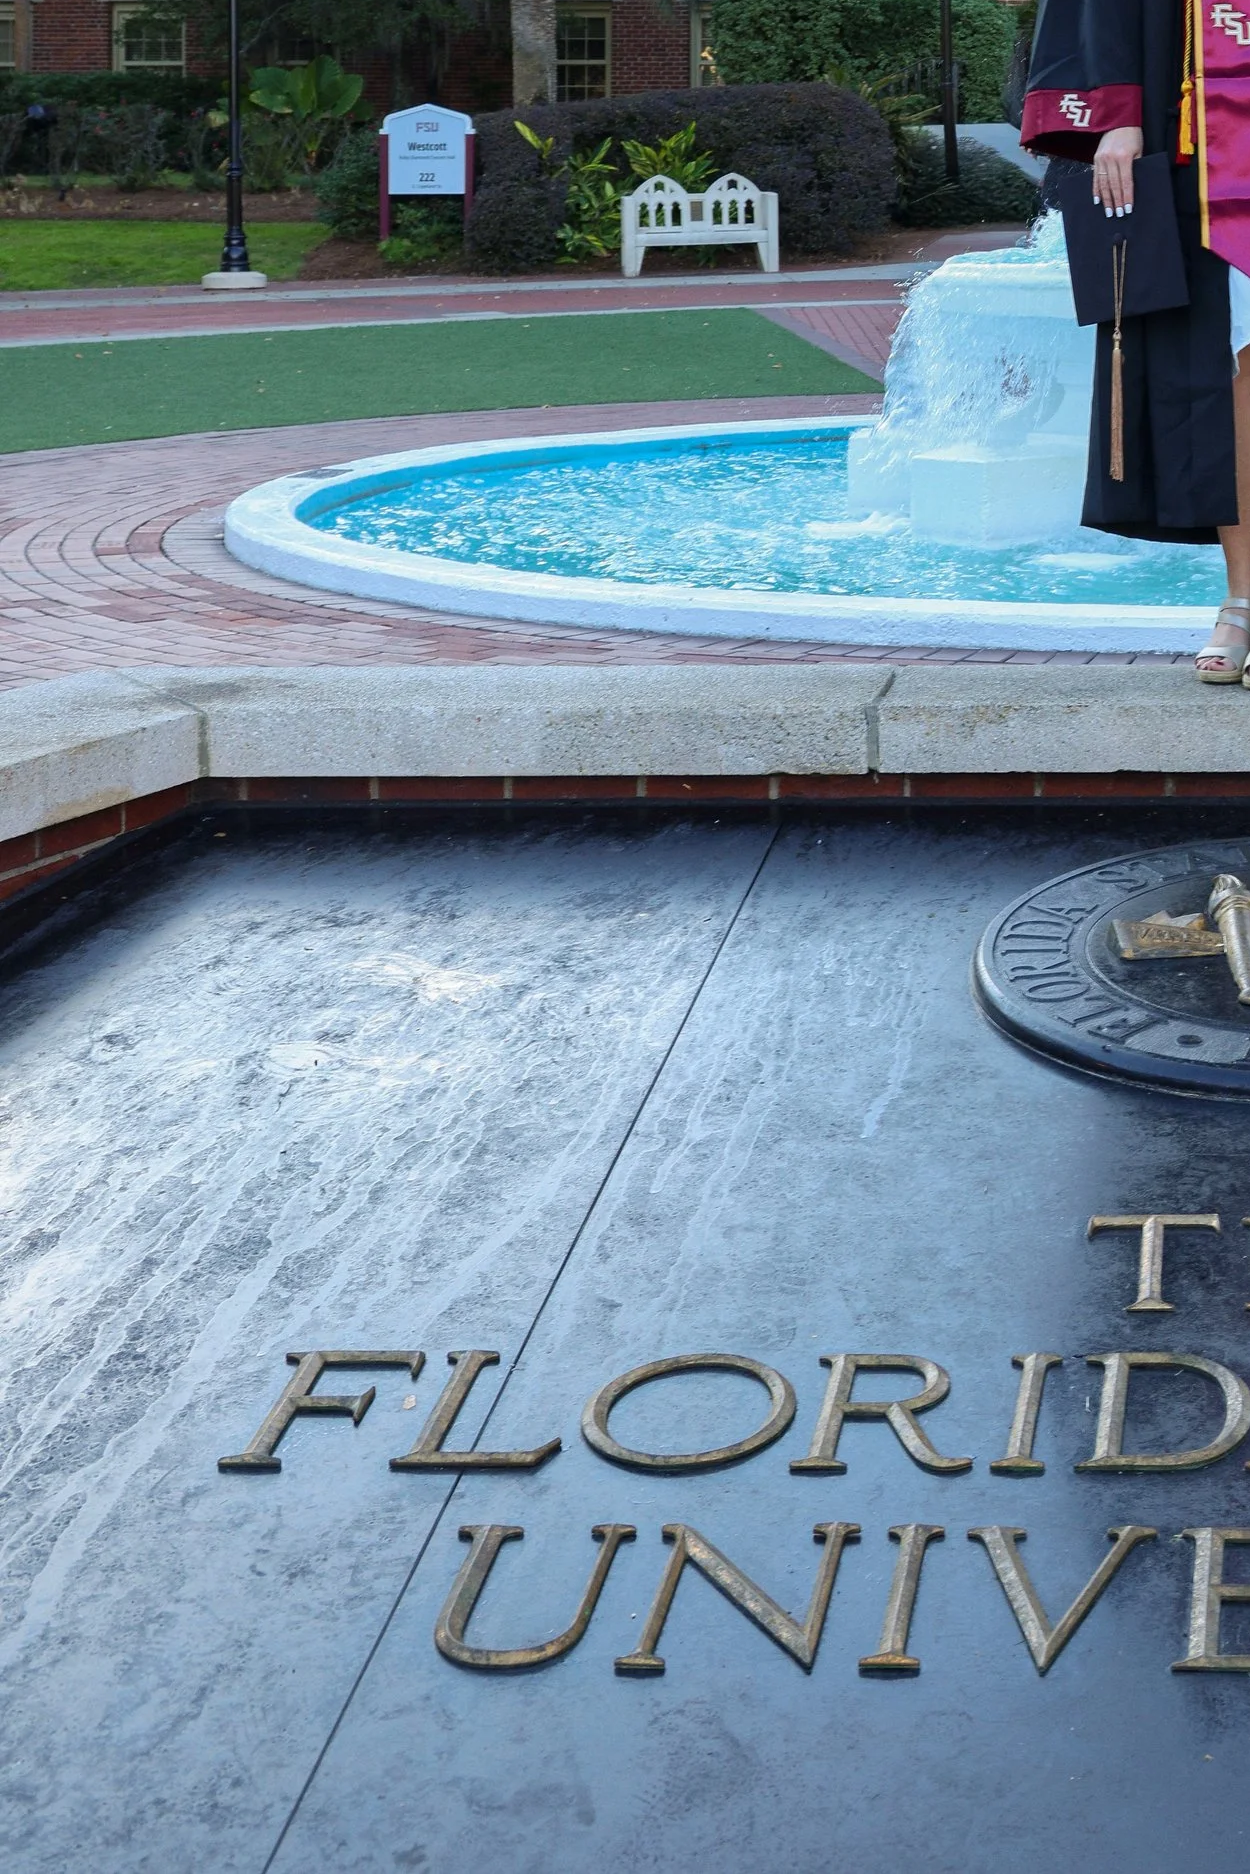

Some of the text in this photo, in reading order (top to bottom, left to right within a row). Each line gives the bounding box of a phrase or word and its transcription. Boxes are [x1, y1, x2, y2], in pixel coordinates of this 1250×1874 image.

[1059, 93, 1092, 127] FSU
[415, 122, 440, 133] FSU
[407, 142, 448, 152] Westcott
[418, 172, 436, 182] 222
[1001, 903, 1163, 1044] FLORIDA
